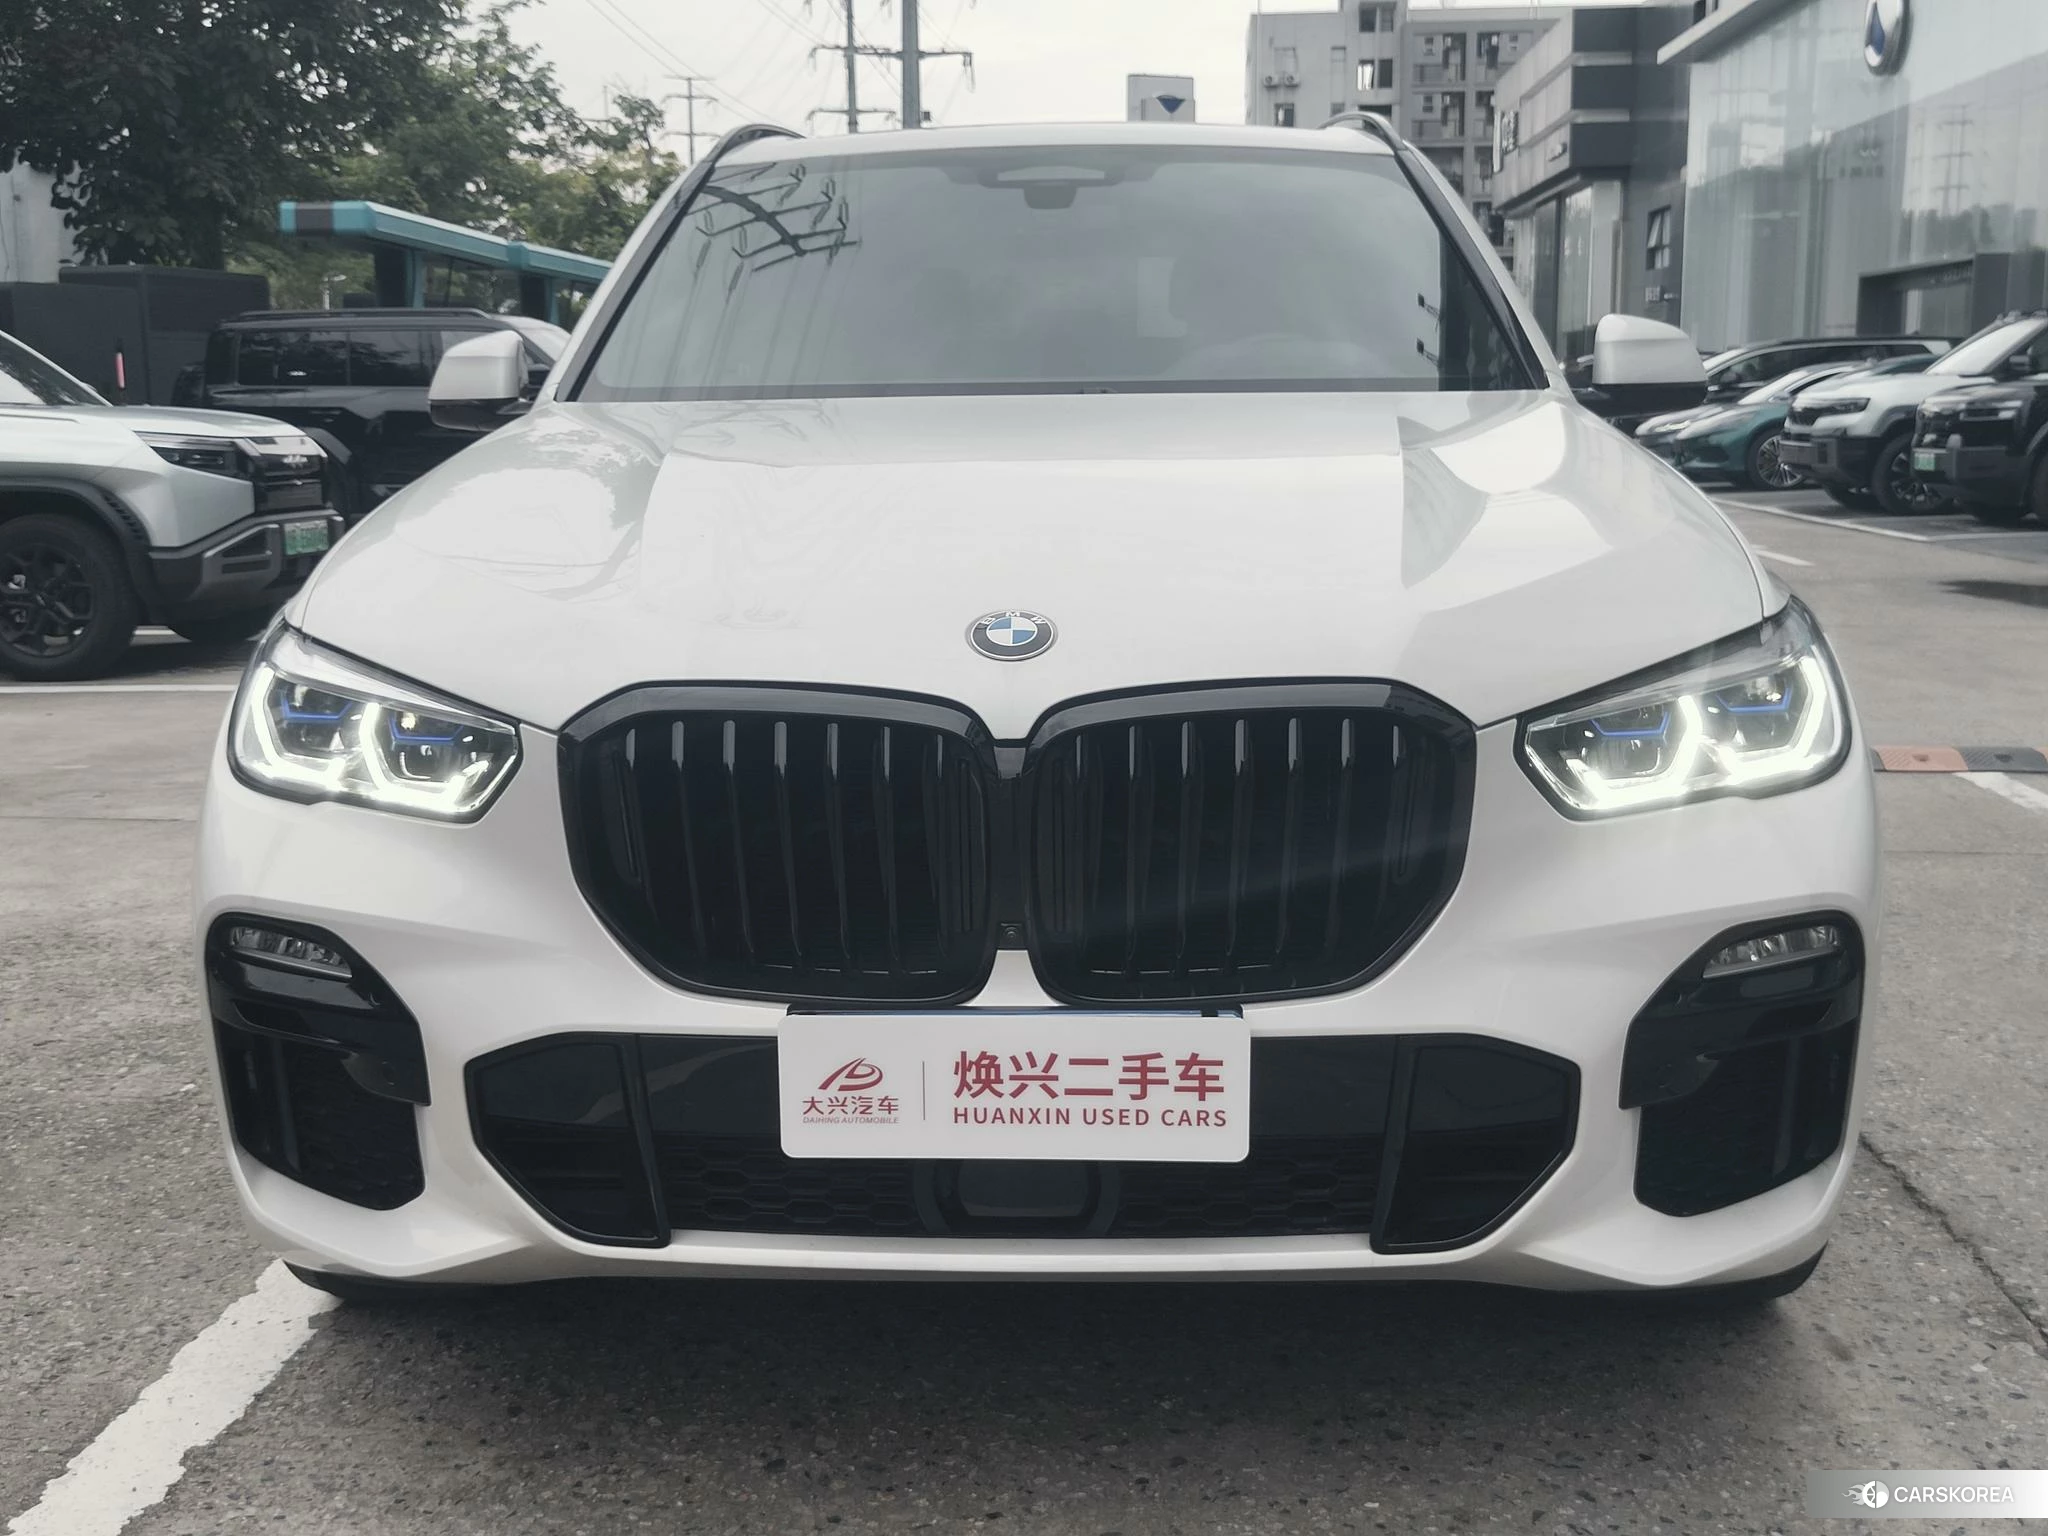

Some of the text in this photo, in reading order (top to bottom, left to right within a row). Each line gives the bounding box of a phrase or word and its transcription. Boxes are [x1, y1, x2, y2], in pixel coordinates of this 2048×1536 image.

[953, 1050, 1225, 1102] 焕兴二手车
[802, 1095, 899, 1115] 大兴汽车
[841, 1116, 899, 1124] AUTOMOBILE
[953, 1107, 1227, 1127] HUANXIN USED CARS
